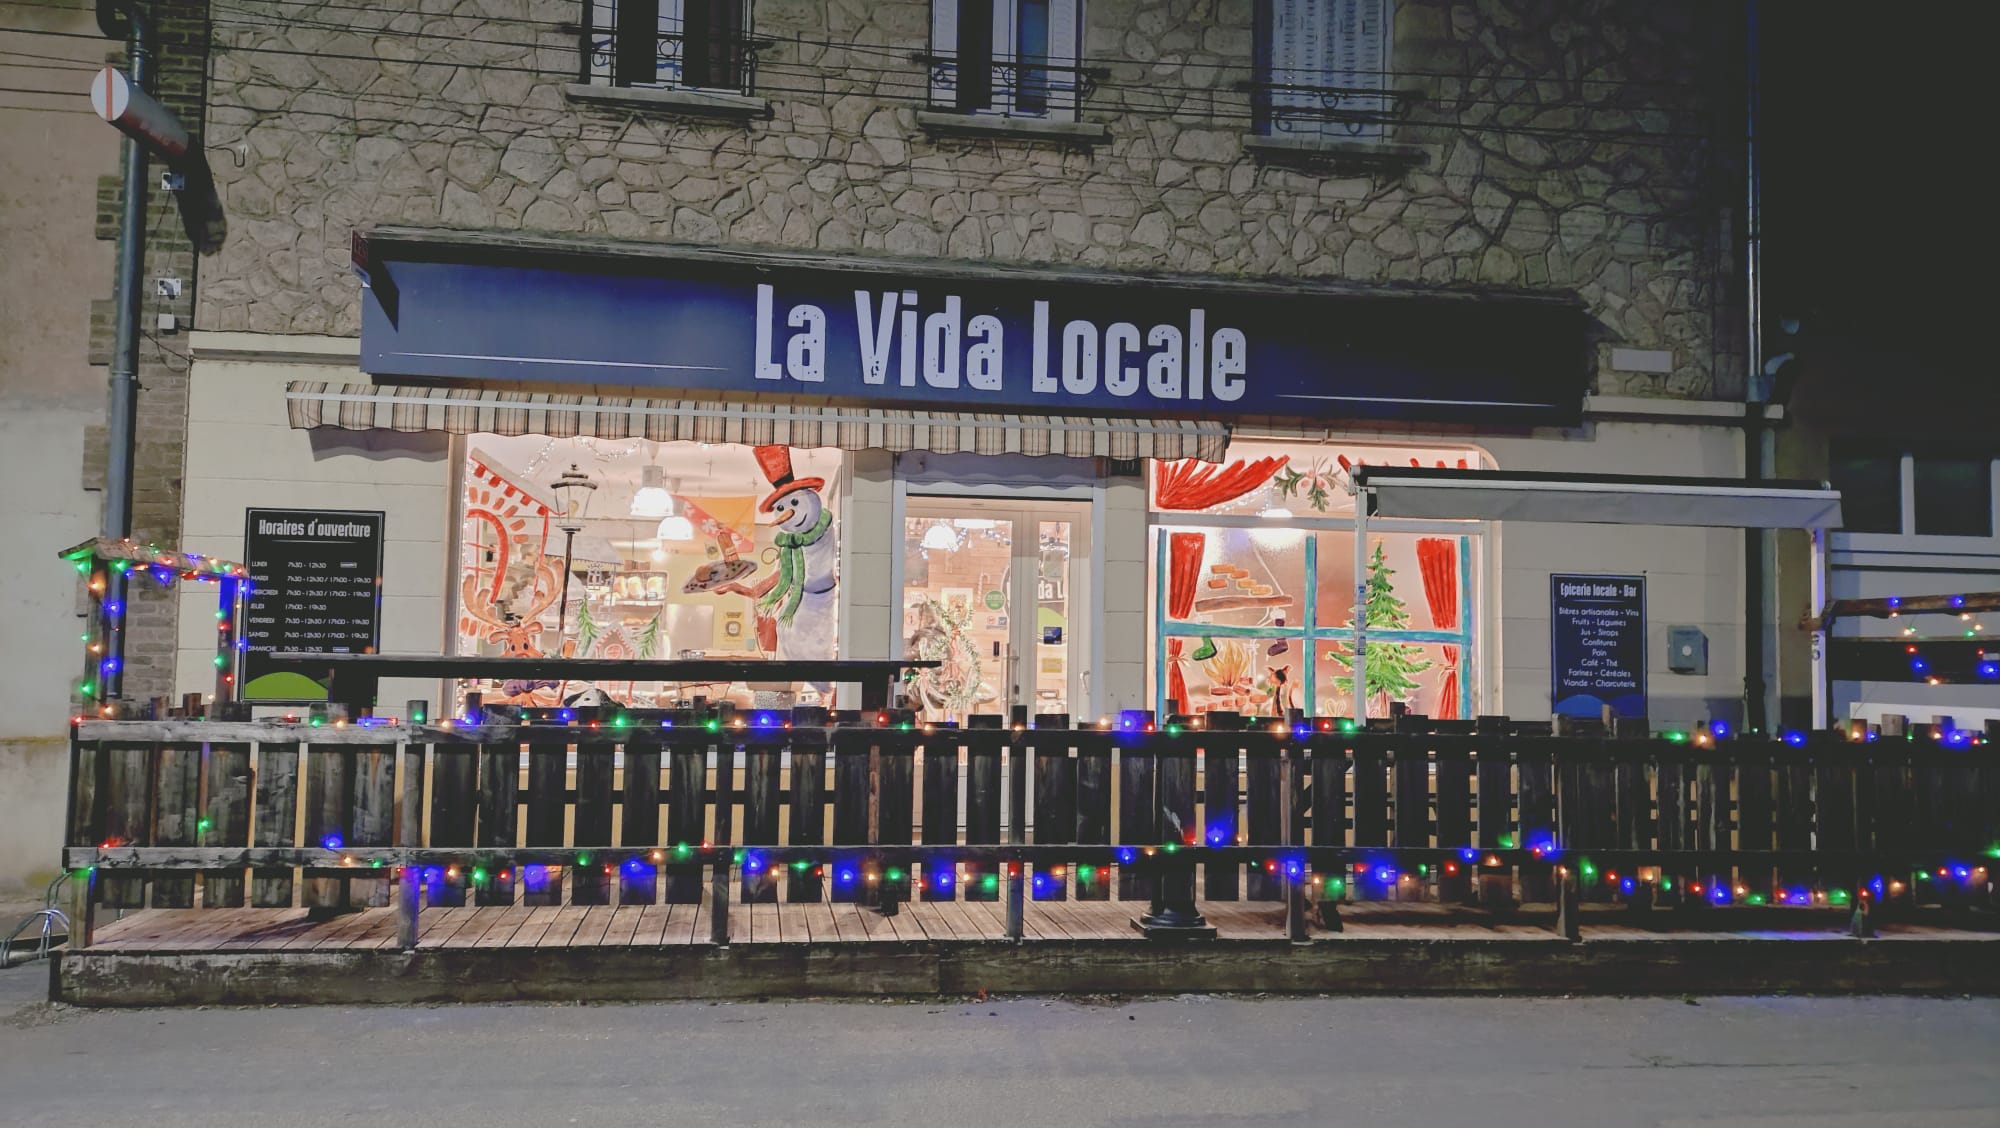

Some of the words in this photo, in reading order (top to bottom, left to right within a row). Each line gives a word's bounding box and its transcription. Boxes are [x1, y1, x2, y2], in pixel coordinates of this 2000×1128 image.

[754, 283, 826, 383] La
[854, 289, 1004, 391] Vida
[1032, 300, 1246, 400] Locale
[259, 520, 304, 536] Horaires
[308, 518, 371, 537] d'ouverture
[1561, 583, 1591, 597] Epicerie
[1593, 584, 1617, 596] locale
[1624, 584, 1637, 597] Bar
[1597, 618, 1626, 627] Légumes
[1598, 629, 1618, 637] Sirops
[1582, 638, 1616, 646] Confitures
[1606, 659, 1618, 667] Thé
[1600, 669, 1631, 677] Céréales
